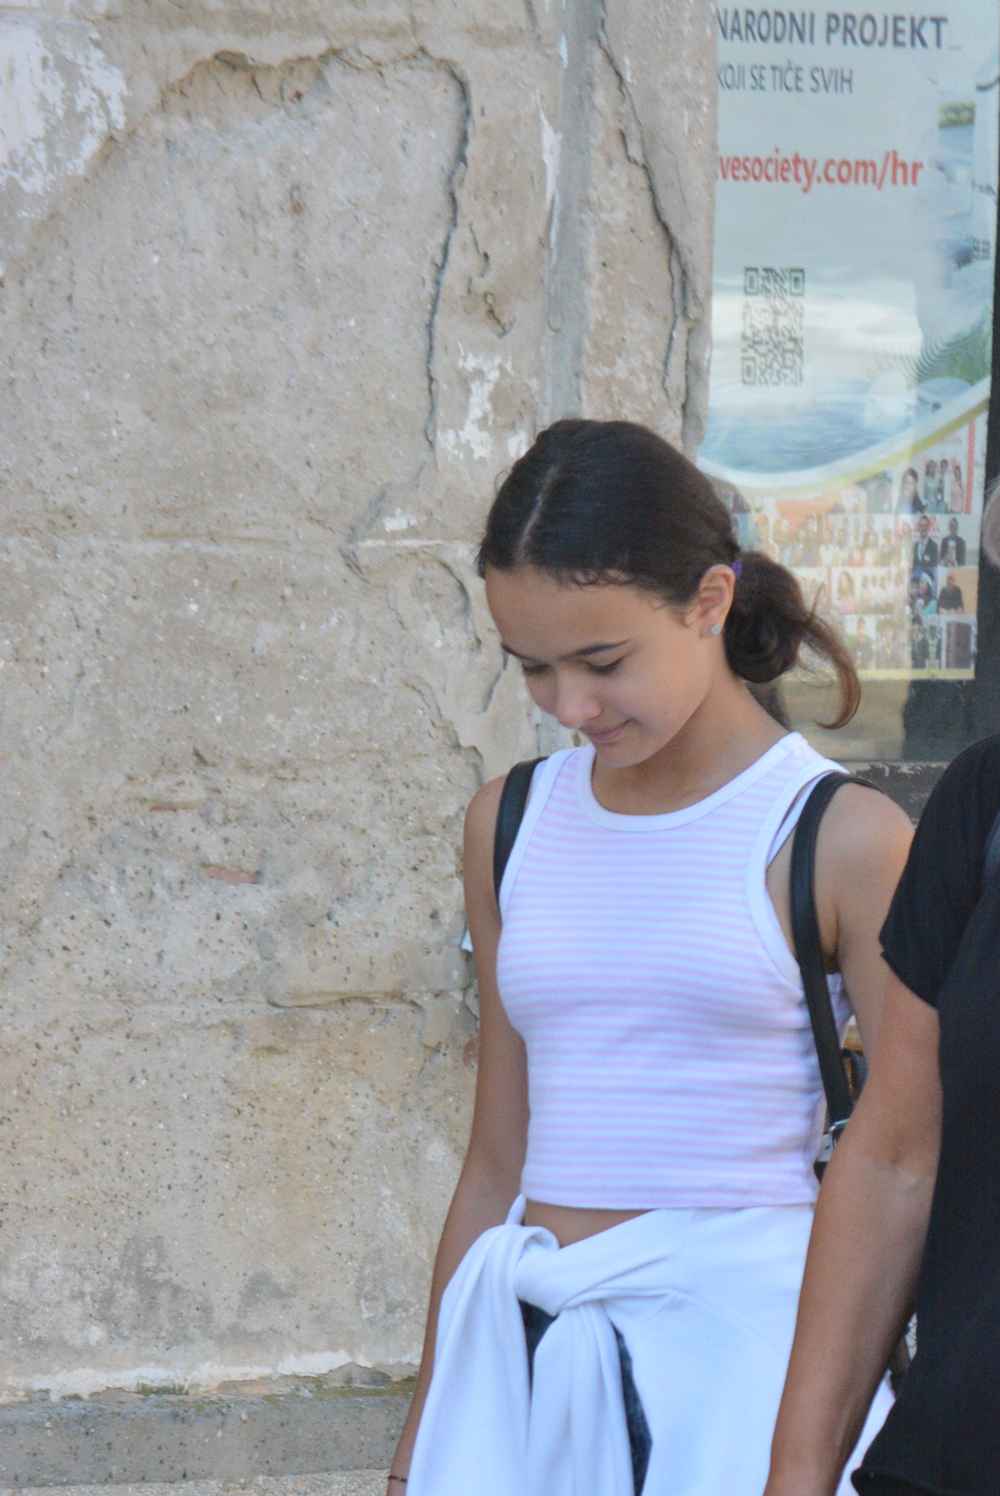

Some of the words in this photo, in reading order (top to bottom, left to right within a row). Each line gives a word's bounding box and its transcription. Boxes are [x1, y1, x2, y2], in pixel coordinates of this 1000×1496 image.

[825, 12, 949, 49] PROJEKT
[750, 64, 767, 92] SE
[810, 67, 854, 94] SVIH
